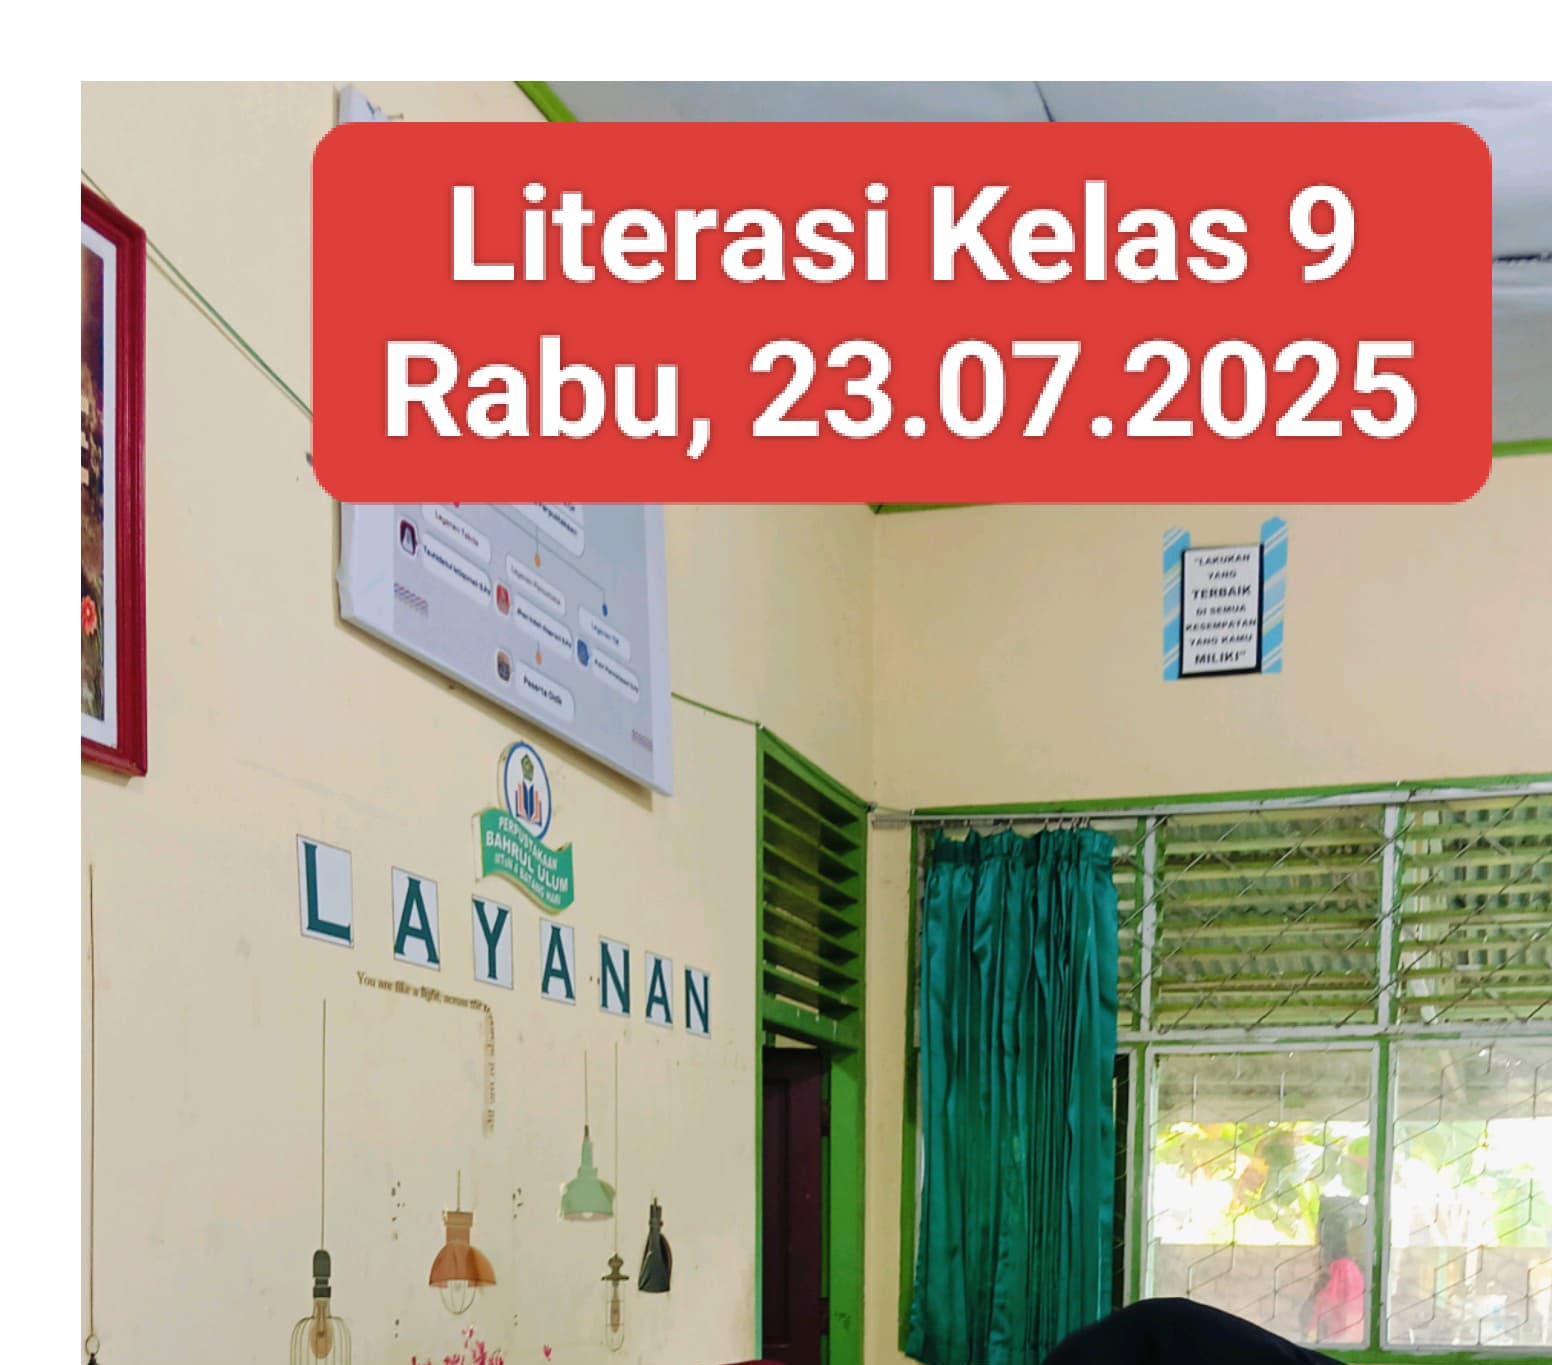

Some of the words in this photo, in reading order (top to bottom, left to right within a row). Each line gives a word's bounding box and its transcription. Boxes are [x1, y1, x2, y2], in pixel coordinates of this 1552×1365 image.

[1192, 584, 1251, 600] TERBAIK
[485, 830, 535, 873] BAHRUL
[537, 867, 569, 893] ULUM
[498, 815, 558, 871] PERPUSTAKAAN
[303, 841, 710, 1034] LAYANAN
[356, 971, 376, 987] You
[377, 980, 393, 992] are
